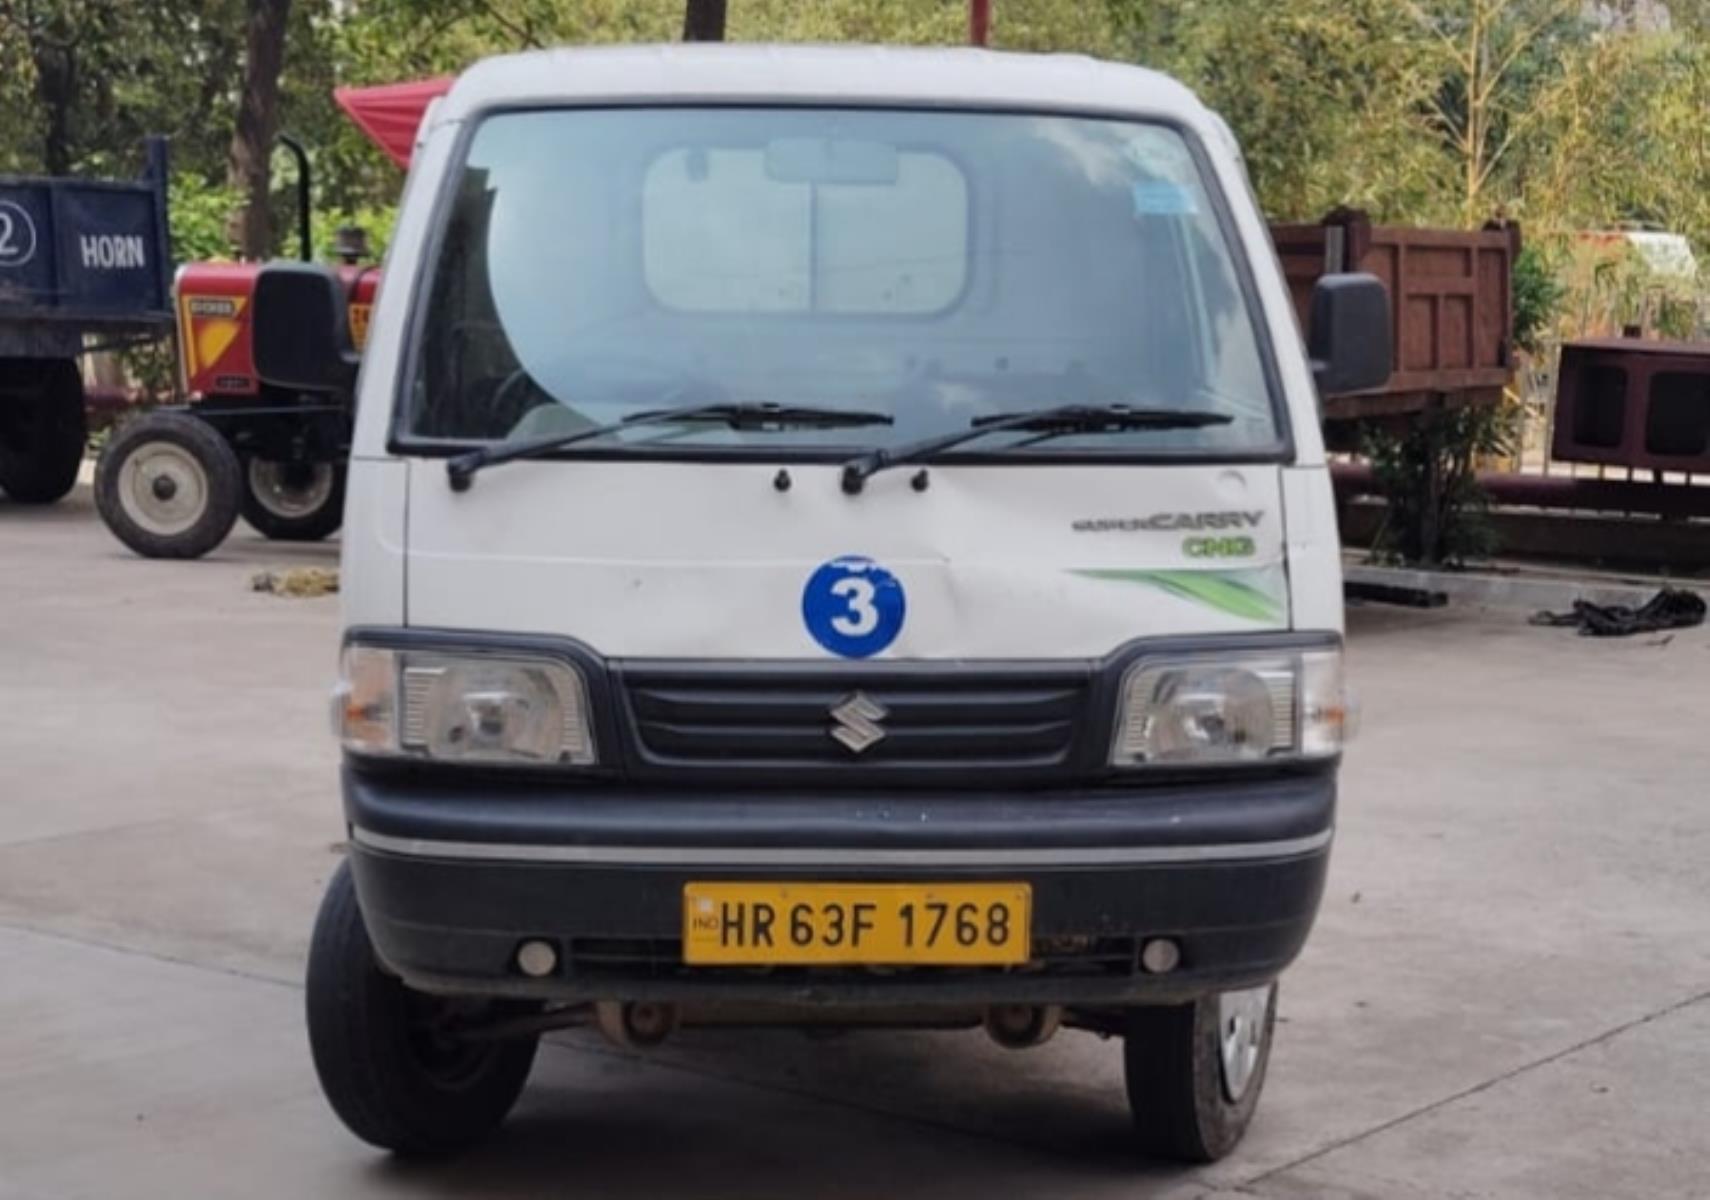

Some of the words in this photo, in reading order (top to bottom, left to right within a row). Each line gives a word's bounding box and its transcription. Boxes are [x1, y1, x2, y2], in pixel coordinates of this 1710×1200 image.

[80, 234, 145, 268] HORN
[830, 576, 879, 636] 3
[721, 902, 775, 948] HR
[790, 902, 877, 948] 63F
[899, 902, 1009, 947] 1768
